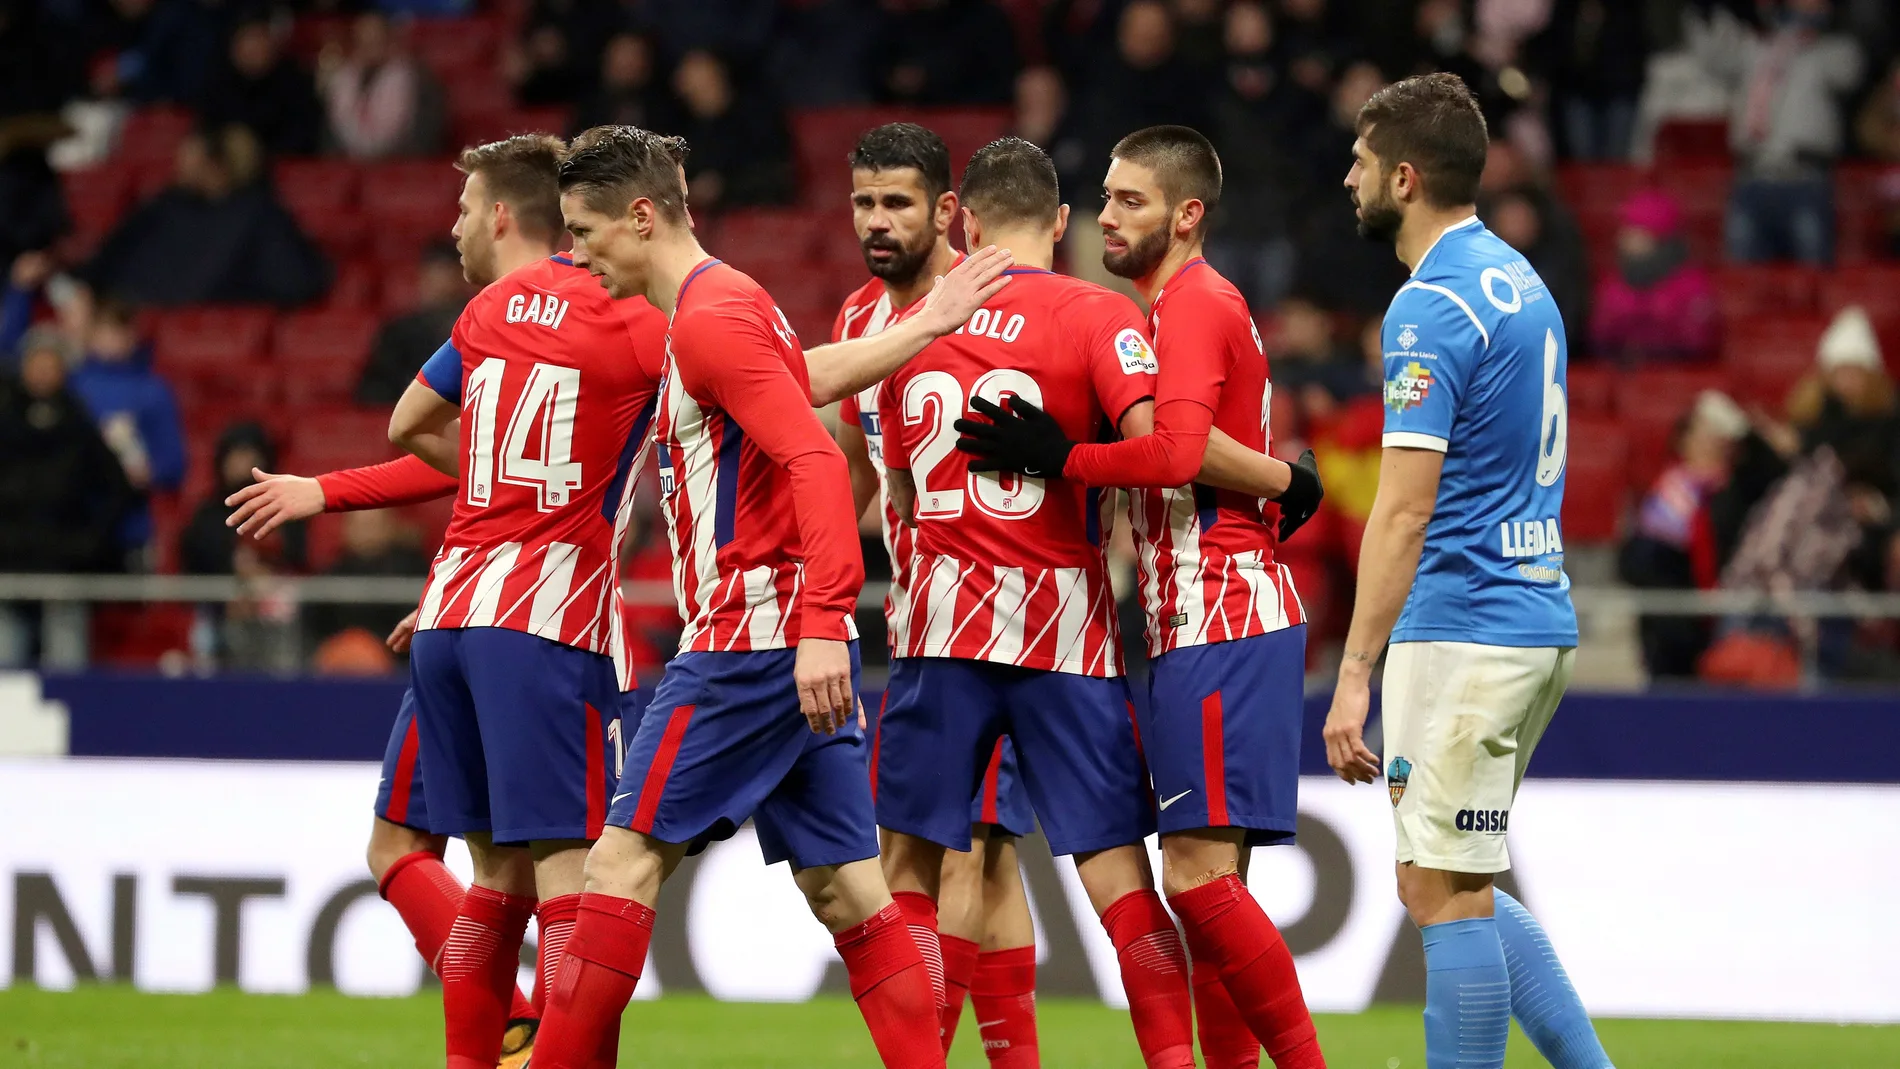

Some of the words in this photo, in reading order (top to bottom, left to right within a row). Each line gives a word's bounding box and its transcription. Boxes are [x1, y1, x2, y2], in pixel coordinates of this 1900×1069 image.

[506, 294, 570, 330] GABI
[1126, 359, 1155, 370] LaLga
[1401, 377, 1429, 389] ara
[1535, 327, 1568, 487] 6
[463, 357, 583, 513] 14
[1501, 518, 1563, 557] LLEDA
[607, 718, 623, 779] 1
[1455, 808, 1509, 832] asisa
[12, 866, 470, 986] NTO
